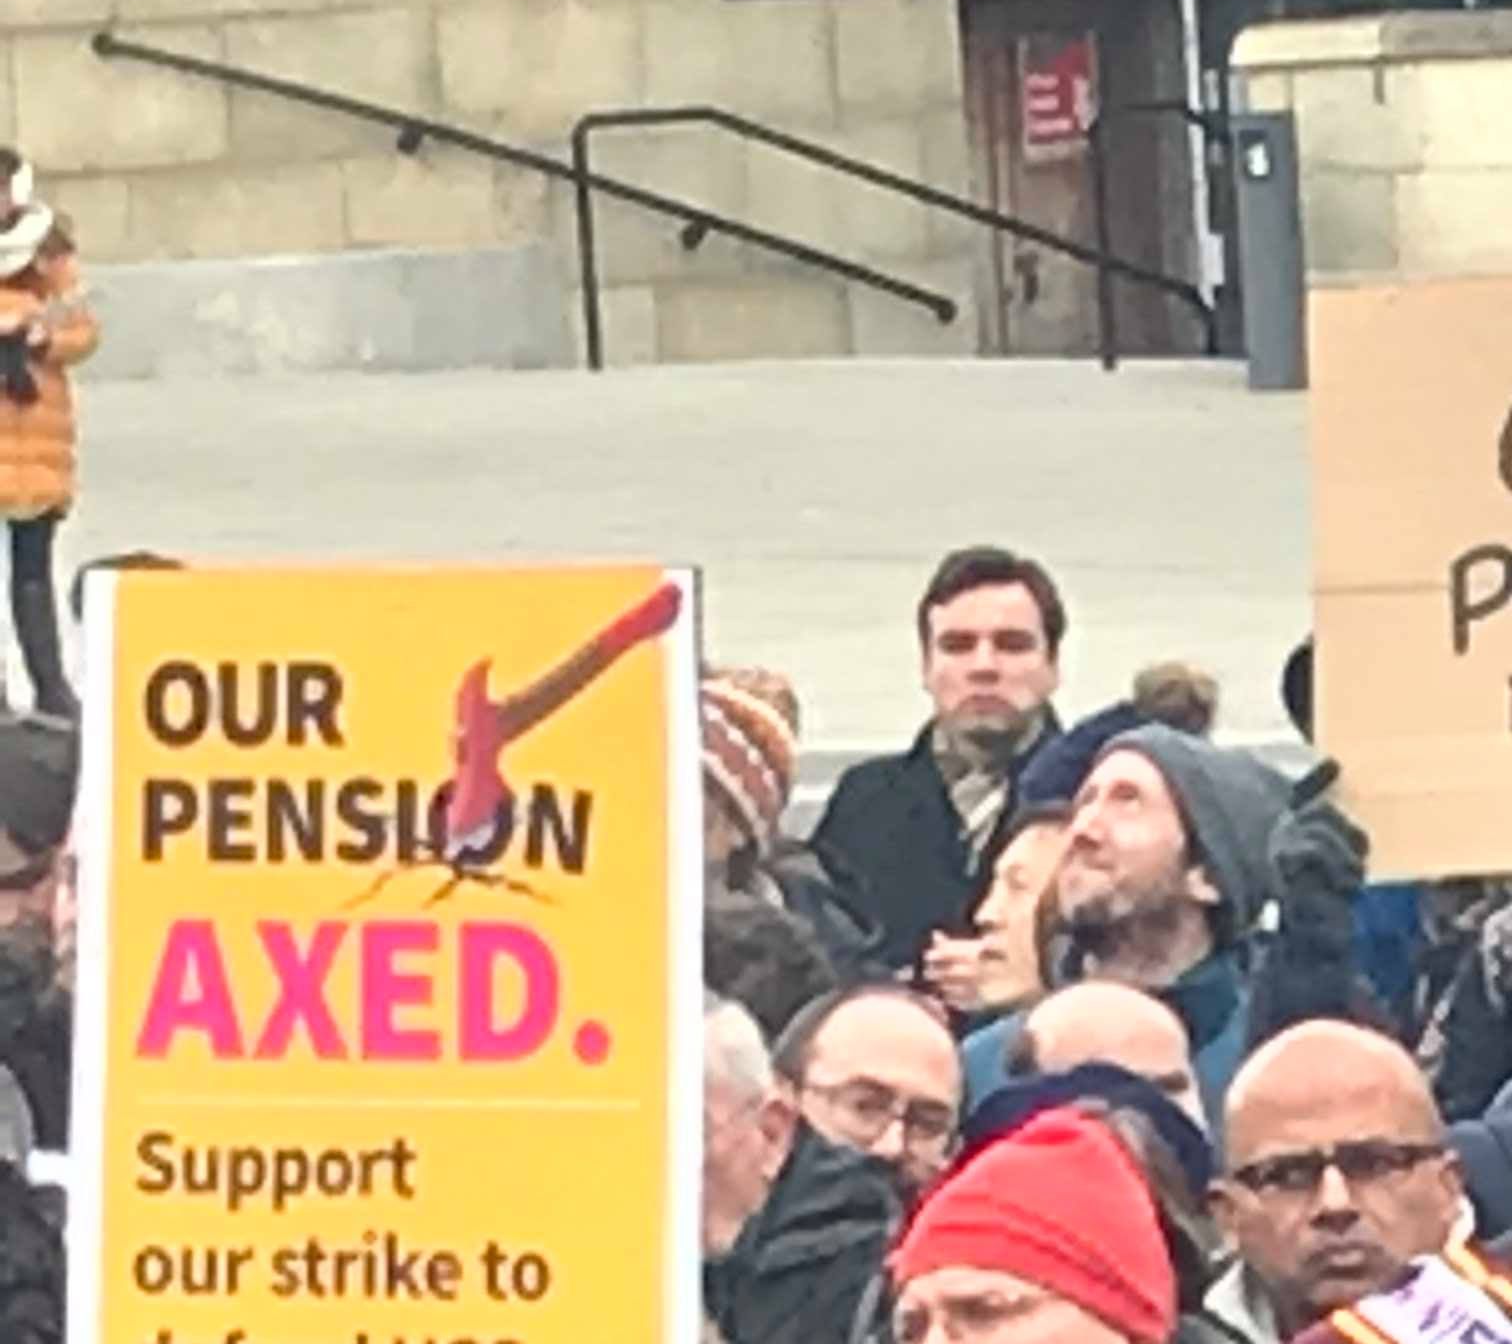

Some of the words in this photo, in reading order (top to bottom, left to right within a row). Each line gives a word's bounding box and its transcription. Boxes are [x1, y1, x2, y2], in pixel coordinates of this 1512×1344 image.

[144, 659, 346, 749] OUR
[141, 776, 594, 875] PENSION
[134, 917, 613, 1067] AXED.
[135, 1131, 418, 1213] Support
[132, 1243, 256, 1296] our
[271, 1229, 464, 1302] strike
[480, 1240, 553, 1302] to
